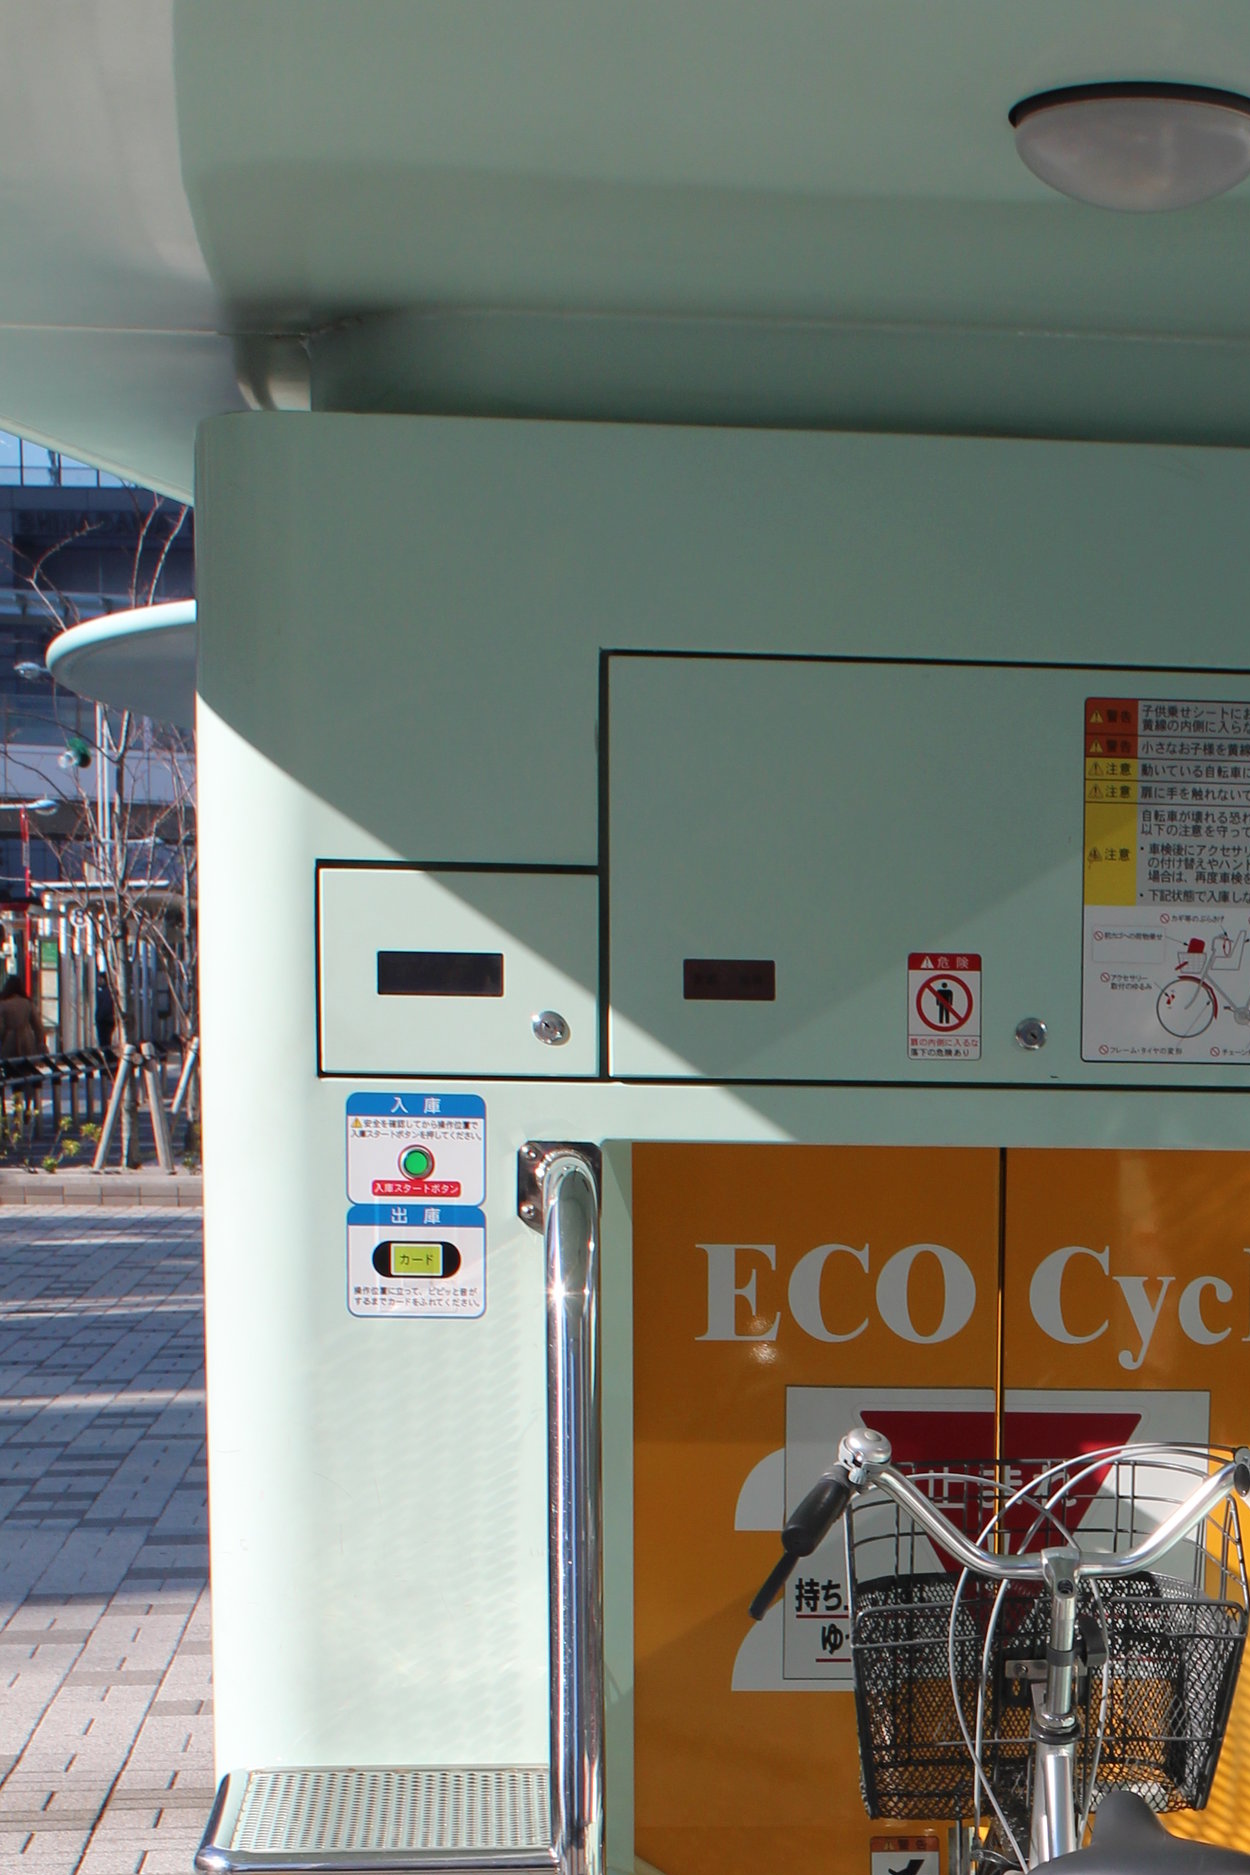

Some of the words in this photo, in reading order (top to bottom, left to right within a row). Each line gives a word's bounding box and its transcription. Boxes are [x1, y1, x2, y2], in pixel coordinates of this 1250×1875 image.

[1106, 763, 1131, 776] 注意
[1105, 785, 1131, 798] 注意
[1105, 848, 1130, 861] 注意
[937, 956, 969, 969] 危険
[391, 1097, 441, 1114] 入庫
[374, 1183, 459, 1194] 入庫スタートボタン
[391, 1208, 441, 1224] 出庫
[400, 1253, 434, 1266] カード
[695, 1243, 976, 1344] ECO
